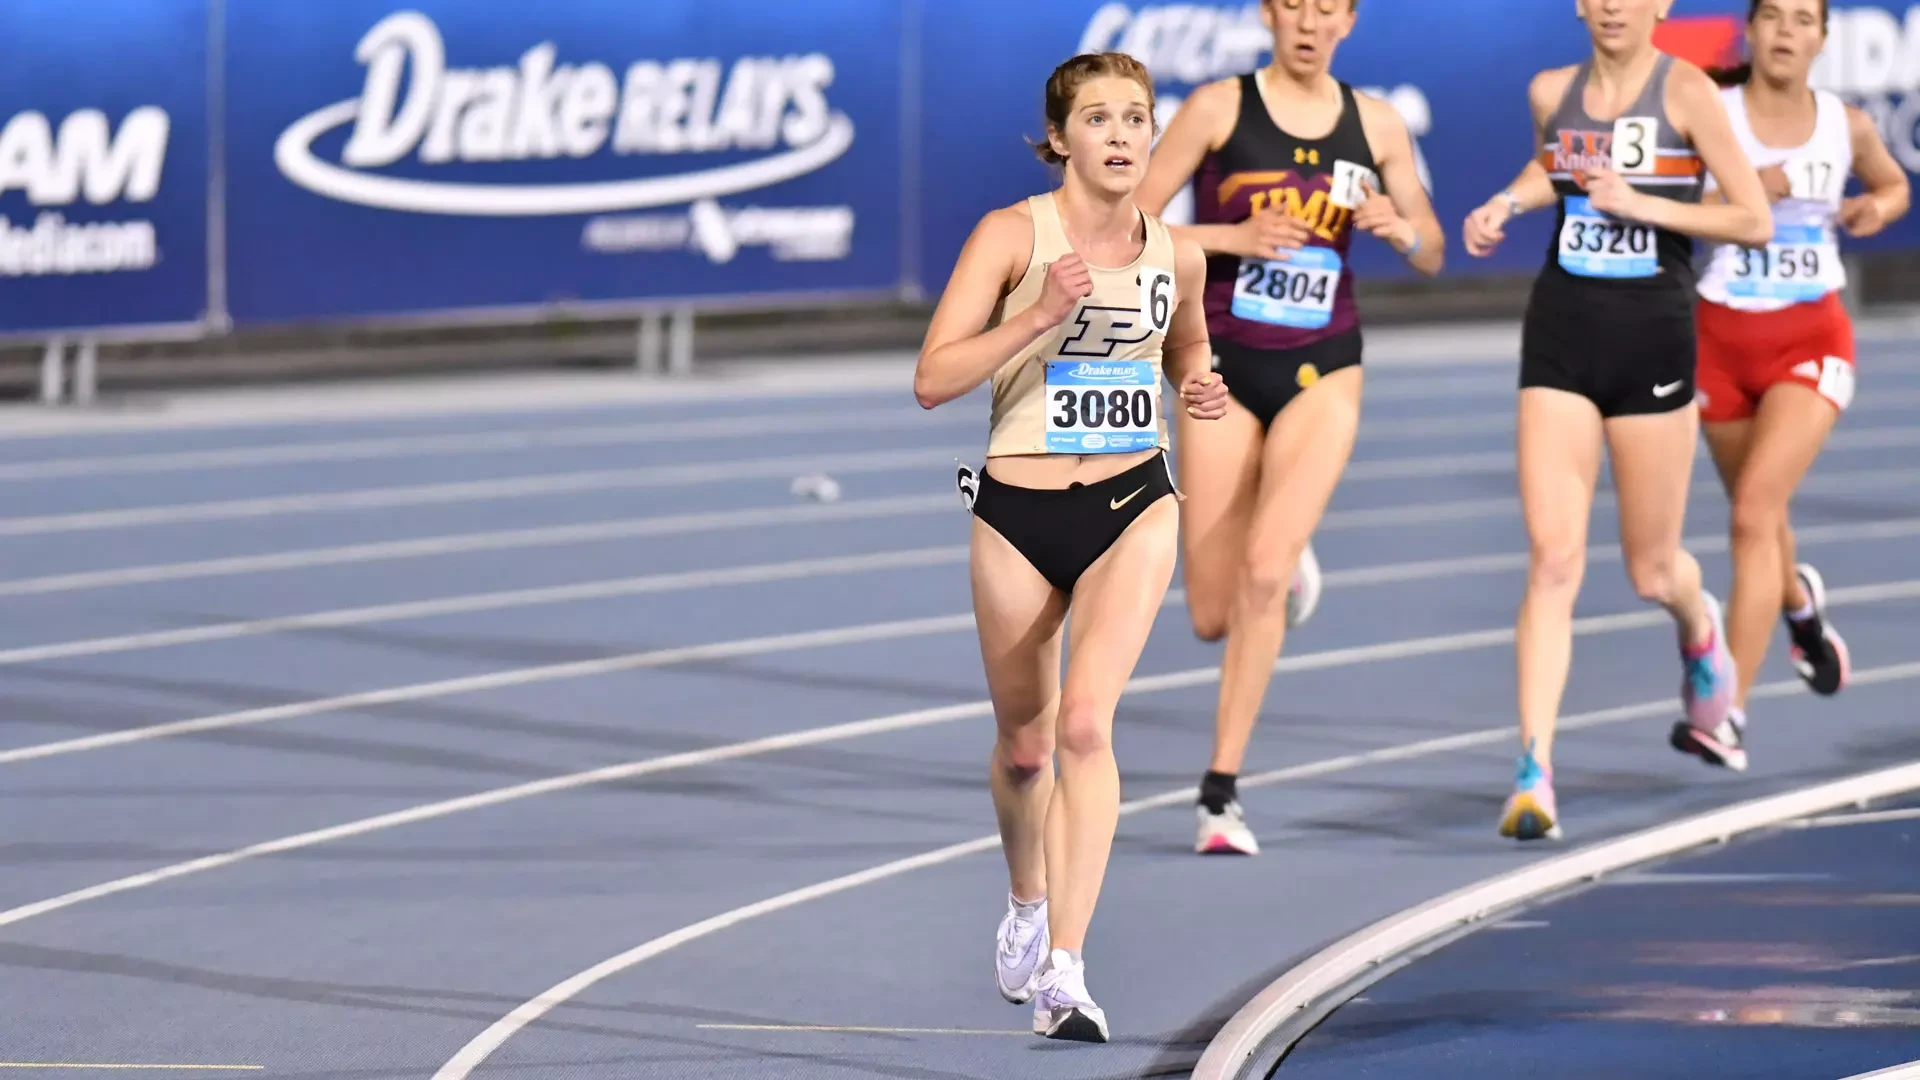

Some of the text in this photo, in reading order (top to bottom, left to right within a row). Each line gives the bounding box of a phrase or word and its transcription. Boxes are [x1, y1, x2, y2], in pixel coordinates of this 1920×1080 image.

[342, 10, 836, 167] Drake RELAYS
[1622, 121, 1645, 169] 3
[1567, 220, 1649, 254] 3320
[1734, 245, 1819, 278] 3159
[1150, 273, 1171, 330] 6
[1242, 262, 1329, 304] 2804
[1057, 305, 1153, 357] P
[1077, 362, 1137, 376] Drake RELAYS
[1052, 389, 1152, 429] 3080
